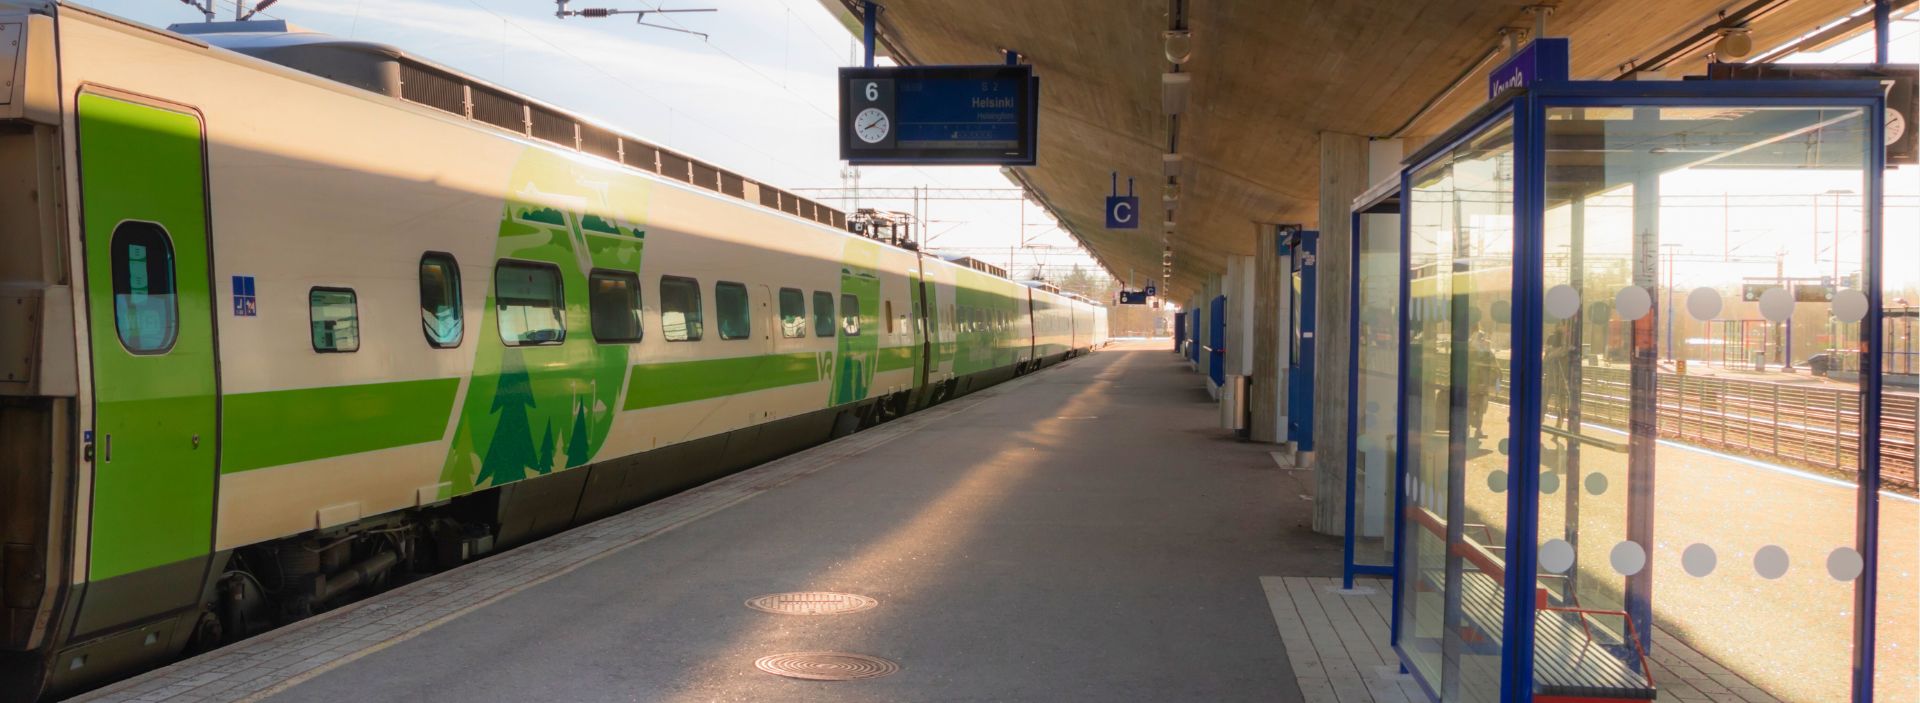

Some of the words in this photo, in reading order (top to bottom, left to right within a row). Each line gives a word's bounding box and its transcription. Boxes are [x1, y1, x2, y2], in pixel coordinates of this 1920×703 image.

[865, 82, 879, 102] 6
[1879, 79, 1896, 104] 7
[972, 96, 1014, 109] Helsinki
[1113, 202, 1132, 223] C
